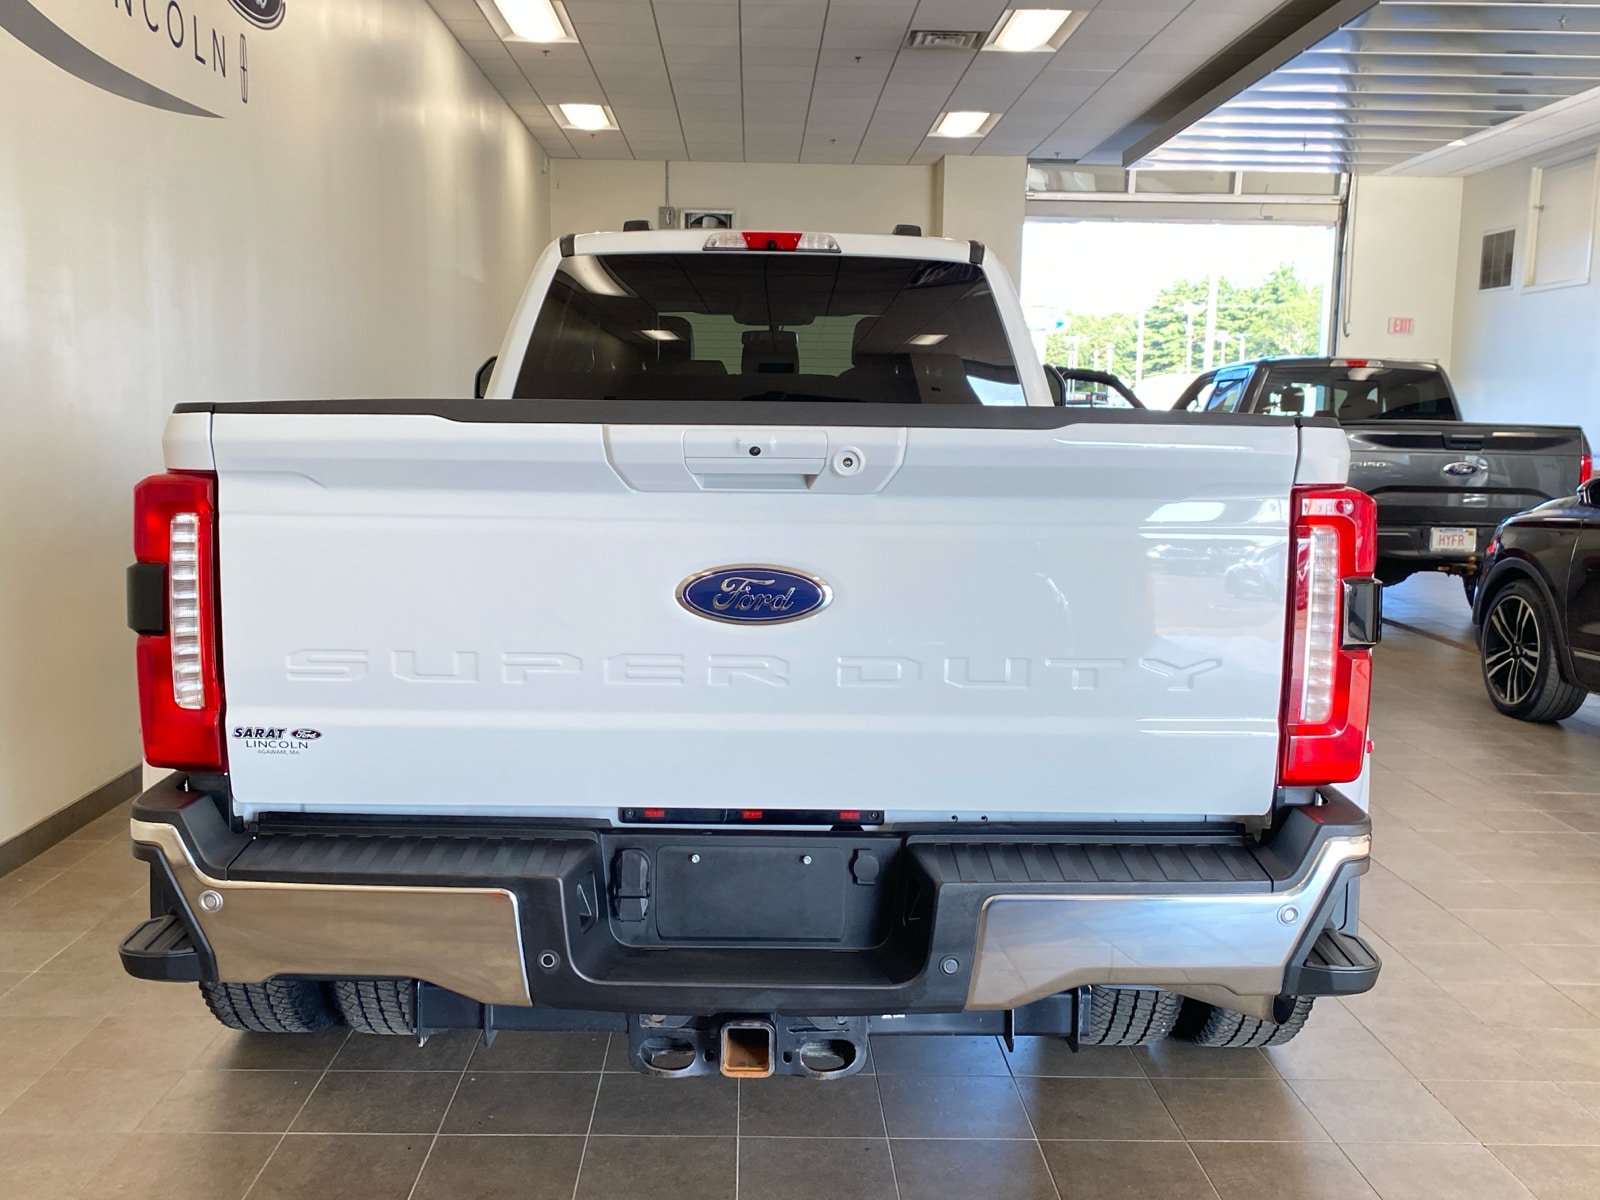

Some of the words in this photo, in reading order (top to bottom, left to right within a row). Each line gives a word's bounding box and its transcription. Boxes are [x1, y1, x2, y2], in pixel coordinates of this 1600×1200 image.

[1438, 533, 1465, 546] HYFR
[712, 576, 796, 611] Ford
[285, 648, 792, 688] SUPER
[836, 655, 1223, 692] DUTY
[233, 727, 286, 739] SARAT
[245, 740, 308, 749] LINCOLN
